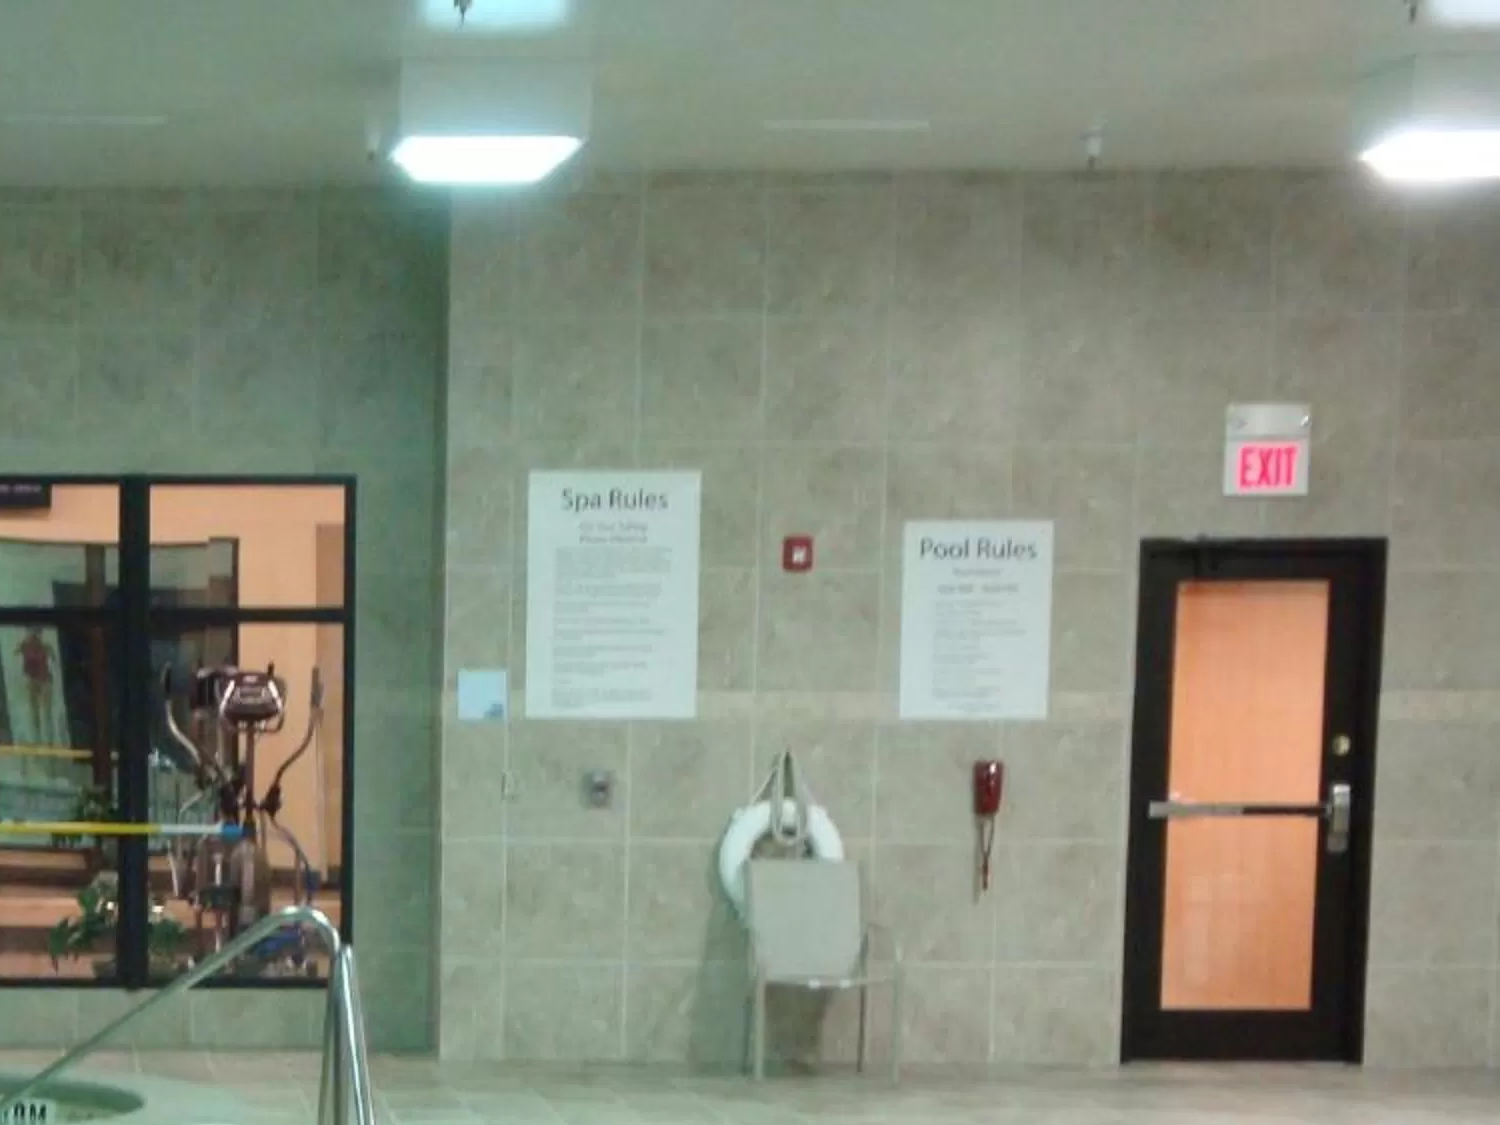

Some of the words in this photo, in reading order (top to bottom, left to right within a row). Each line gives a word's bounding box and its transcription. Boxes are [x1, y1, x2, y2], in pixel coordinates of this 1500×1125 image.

[1239, 446, 1297, 487] EXIT
[561, 487, 601, 512] Spa
[608, 487, 669, 509] Rules
[919, 536, 970, 560] Pool
[976, 536, 1038, 560] Rules
